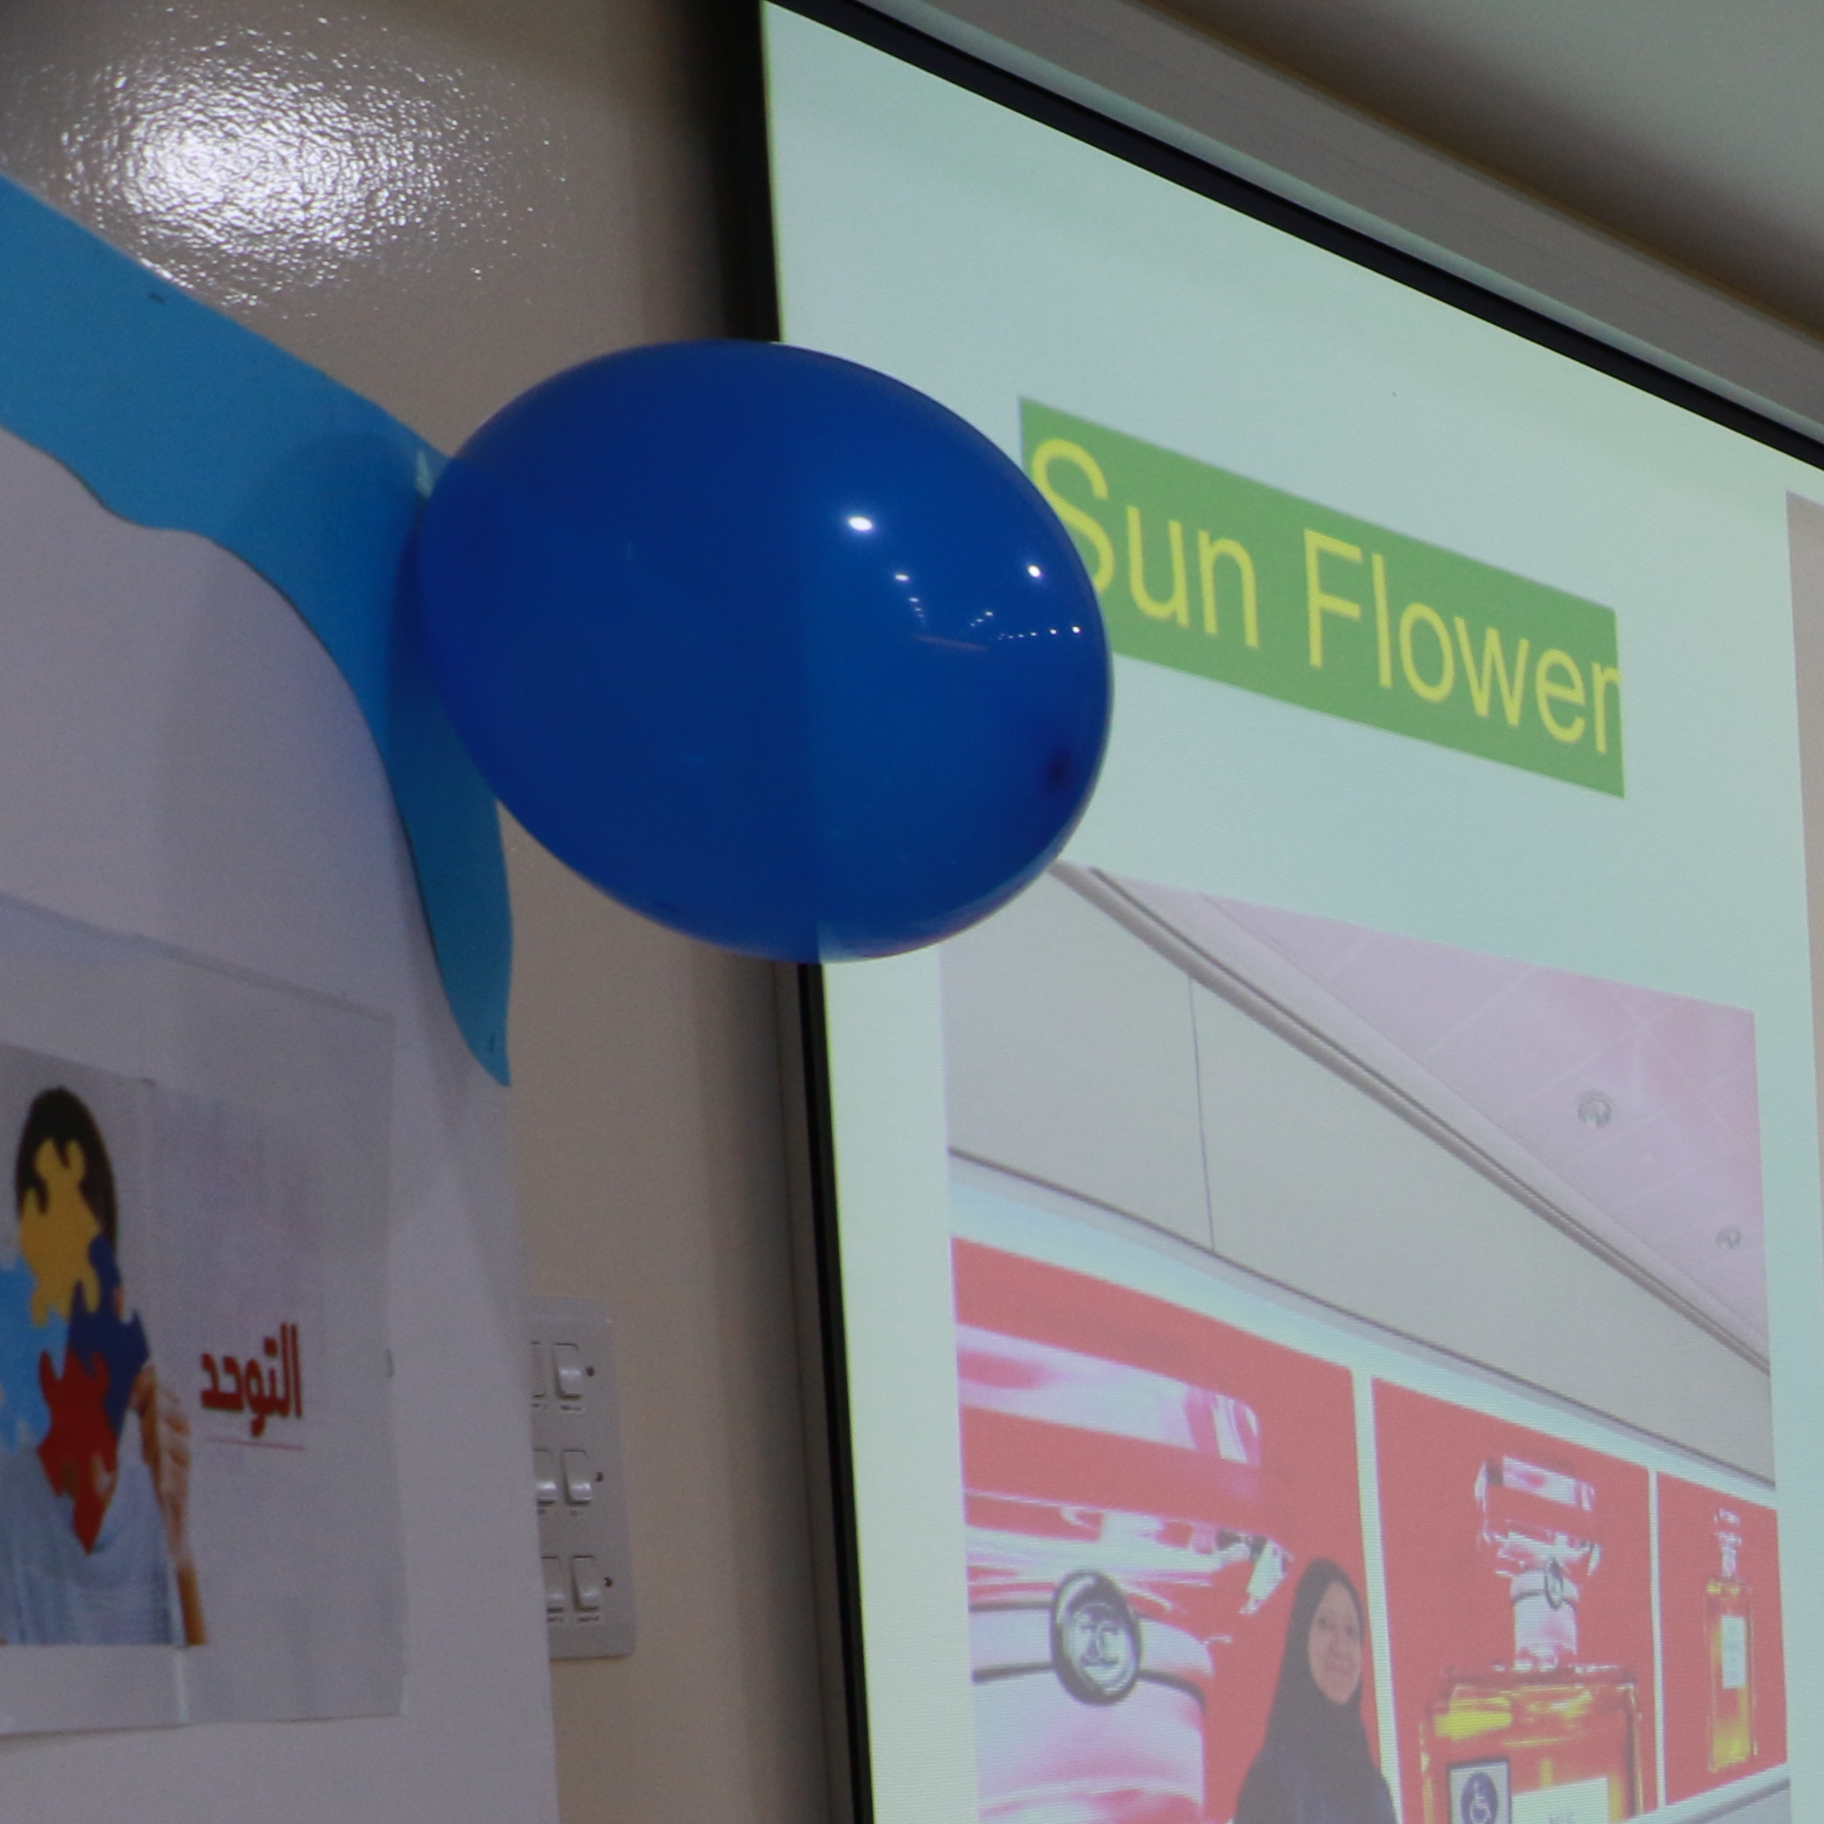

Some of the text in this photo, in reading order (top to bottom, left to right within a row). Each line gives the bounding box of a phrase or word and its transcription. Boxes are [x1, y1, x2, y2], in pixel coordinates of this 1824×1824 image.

[1029, 437, 1622, 755] Sun Flower
[201, 1321, 302, 1438] التوحد
